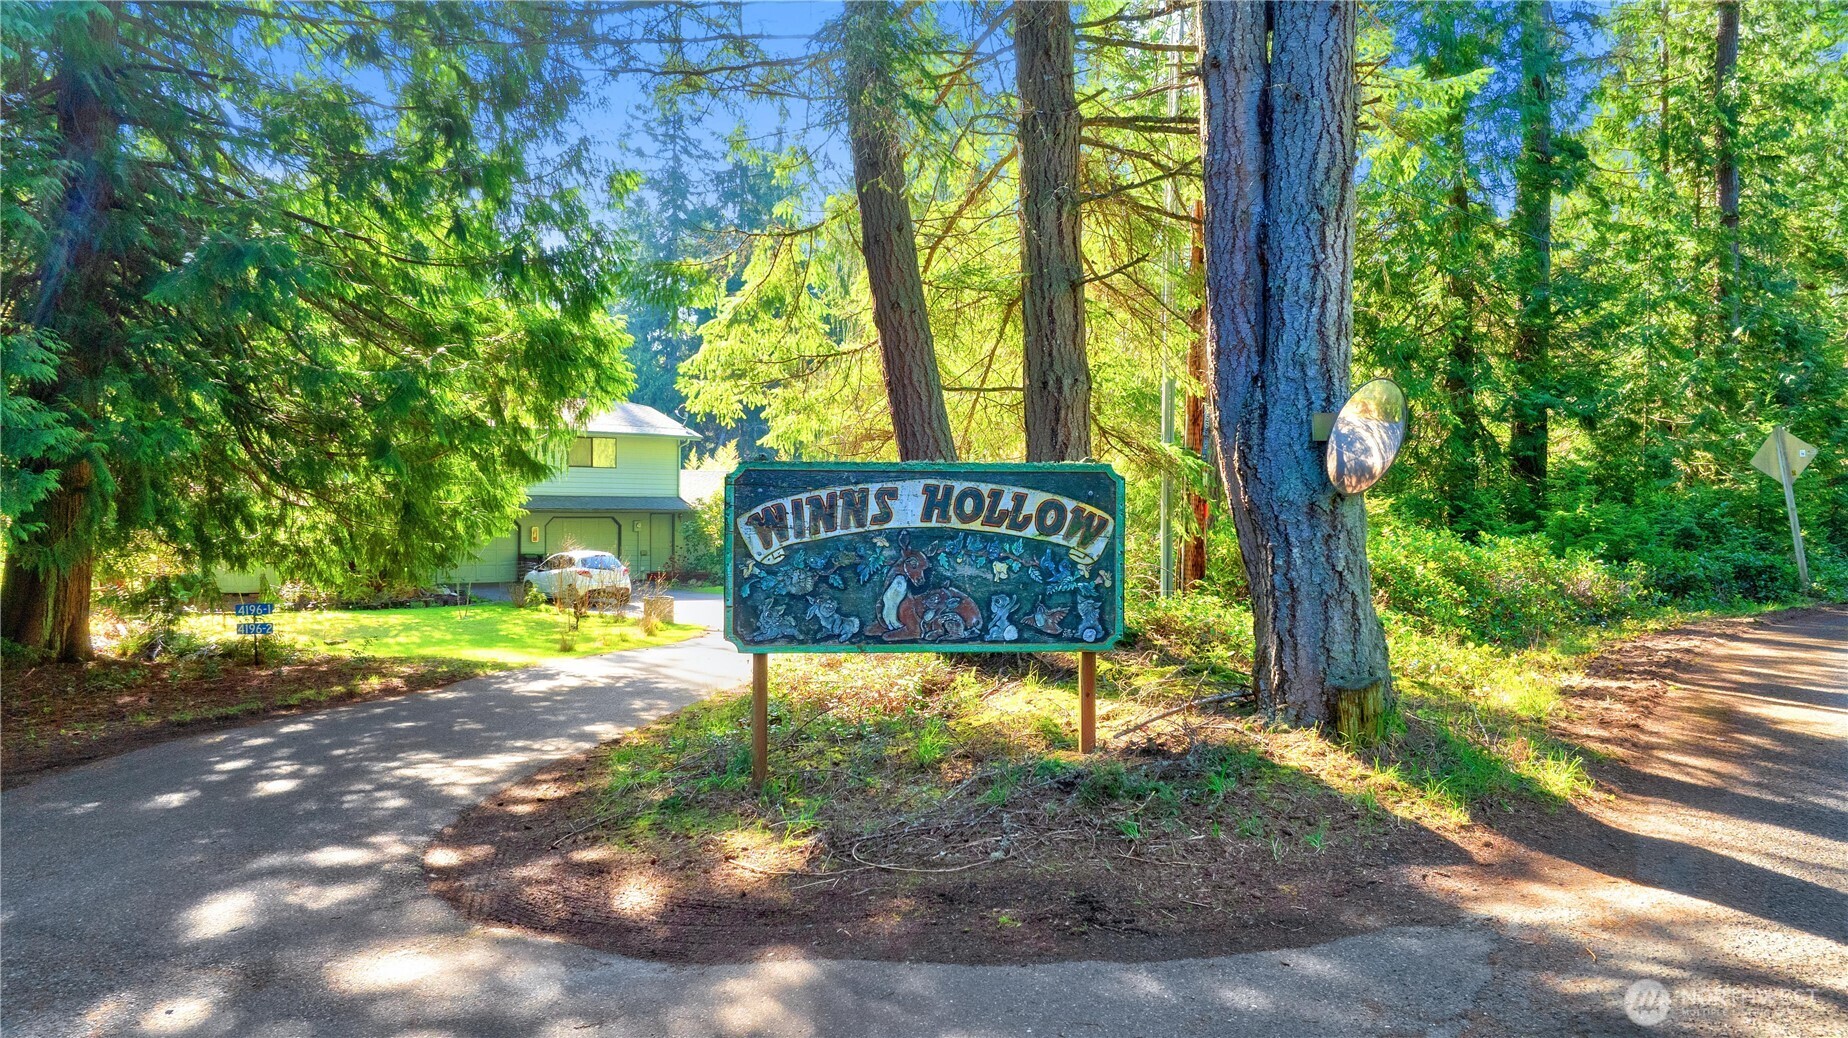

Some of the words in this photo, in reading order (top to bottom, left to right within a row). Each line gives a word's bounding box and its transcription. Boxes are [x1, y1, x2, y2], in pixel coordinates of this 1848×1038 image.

[746, 488, 898, 549] WINNS
[920, 483, 1107, 548] HOLLOW
[238, 604, 271, 615] 4196-1
[238, 624, 272, 634] 4196-2
